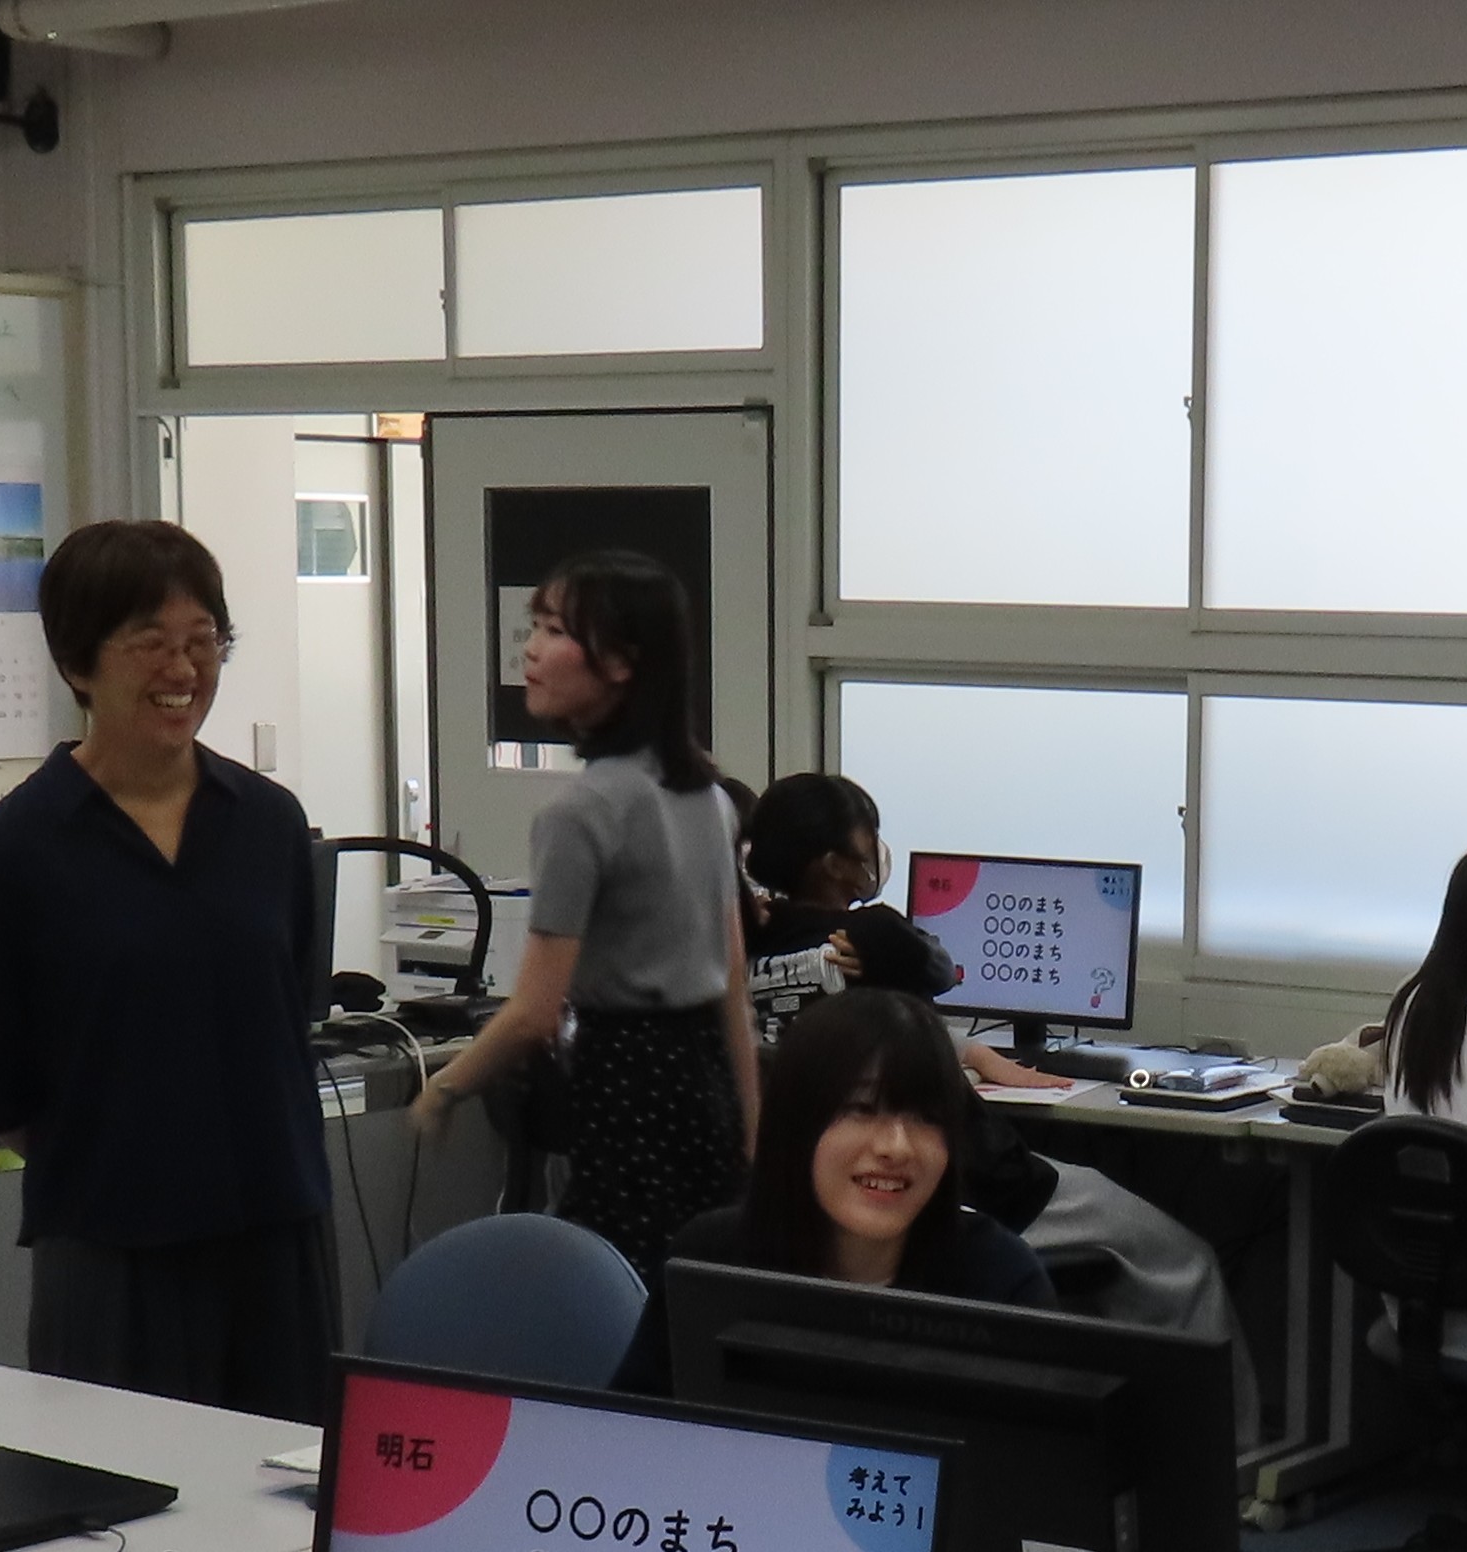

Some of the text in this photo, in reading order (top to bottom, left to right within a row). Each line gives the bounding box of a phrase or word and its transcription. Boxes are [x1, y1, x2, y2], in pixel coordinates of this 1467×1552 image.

[376, 1433, 436, 1471] 明石
[848, 1466, 912, 1496] 考えて
